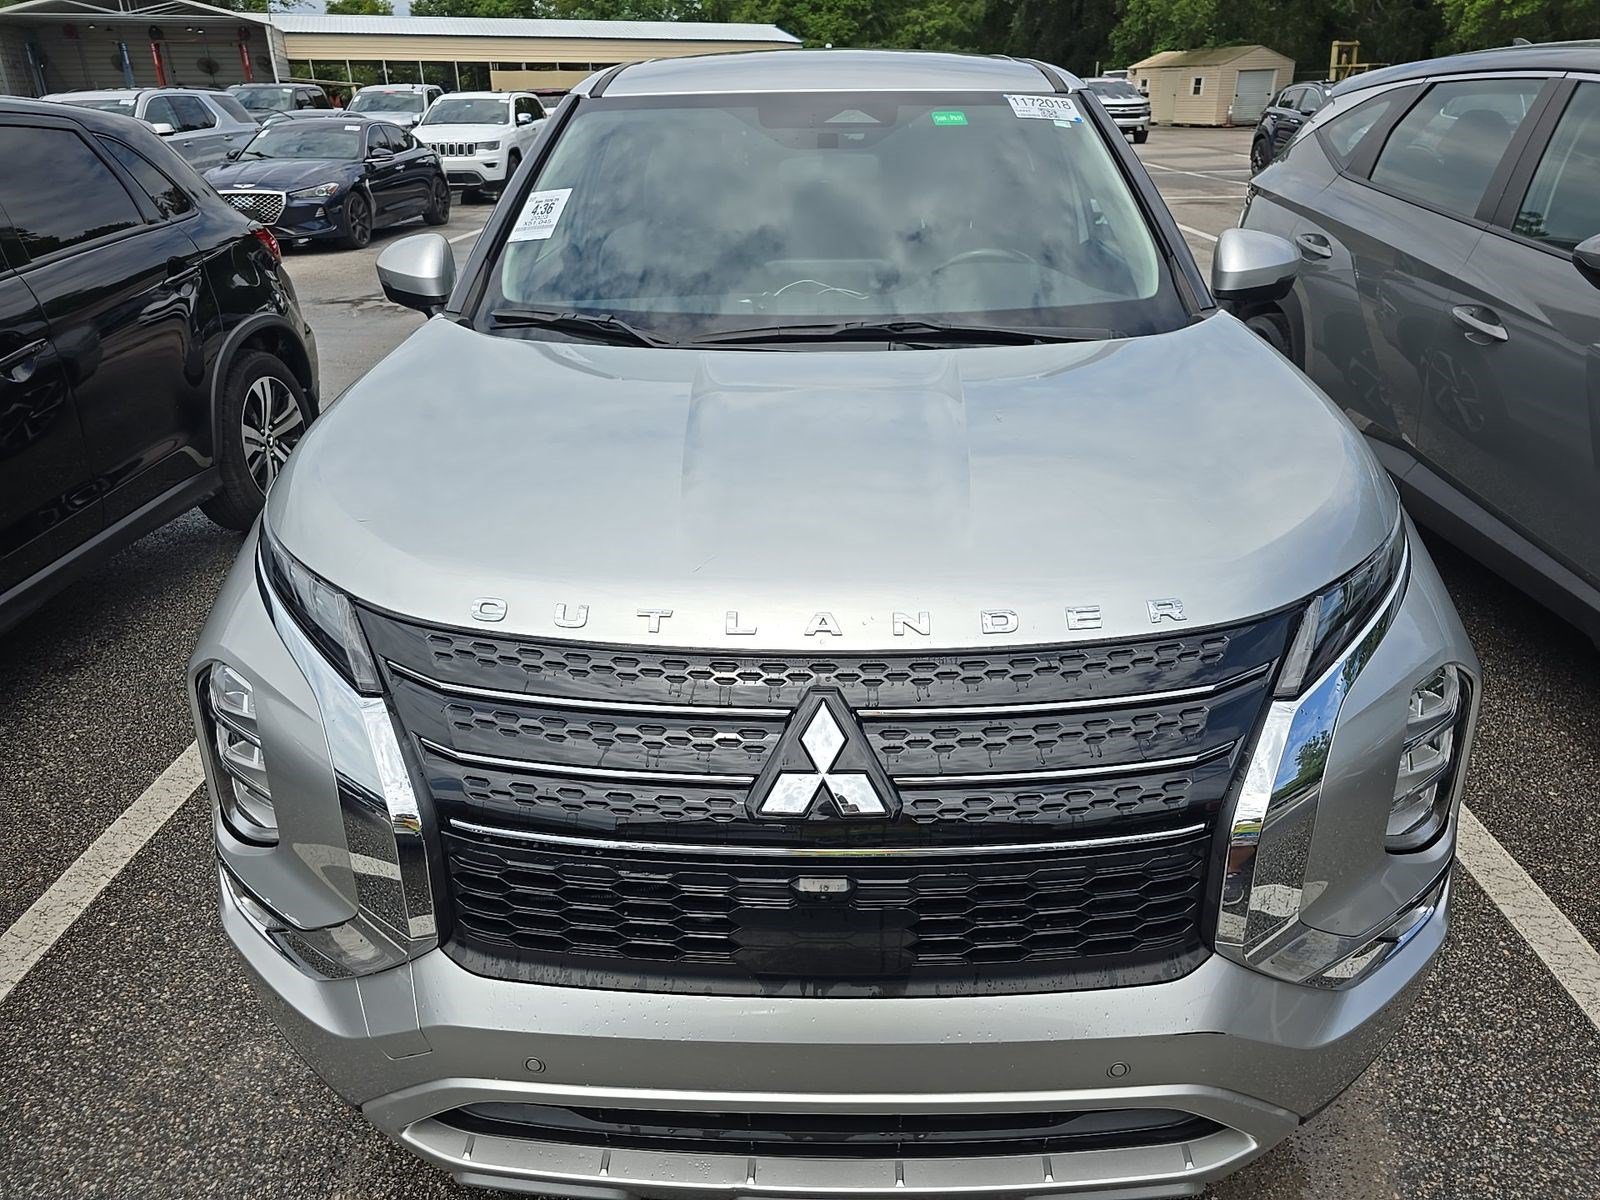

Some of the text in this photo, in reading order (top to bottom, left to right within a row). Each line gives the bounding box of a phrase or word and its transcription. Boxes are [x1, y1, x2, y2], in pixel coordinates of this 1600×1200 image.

[1011, 96, 1071, 110] 1172018
[531, 202, 555, 216] 4:36
[470, 596, 1188, 637] OUTLANDER
